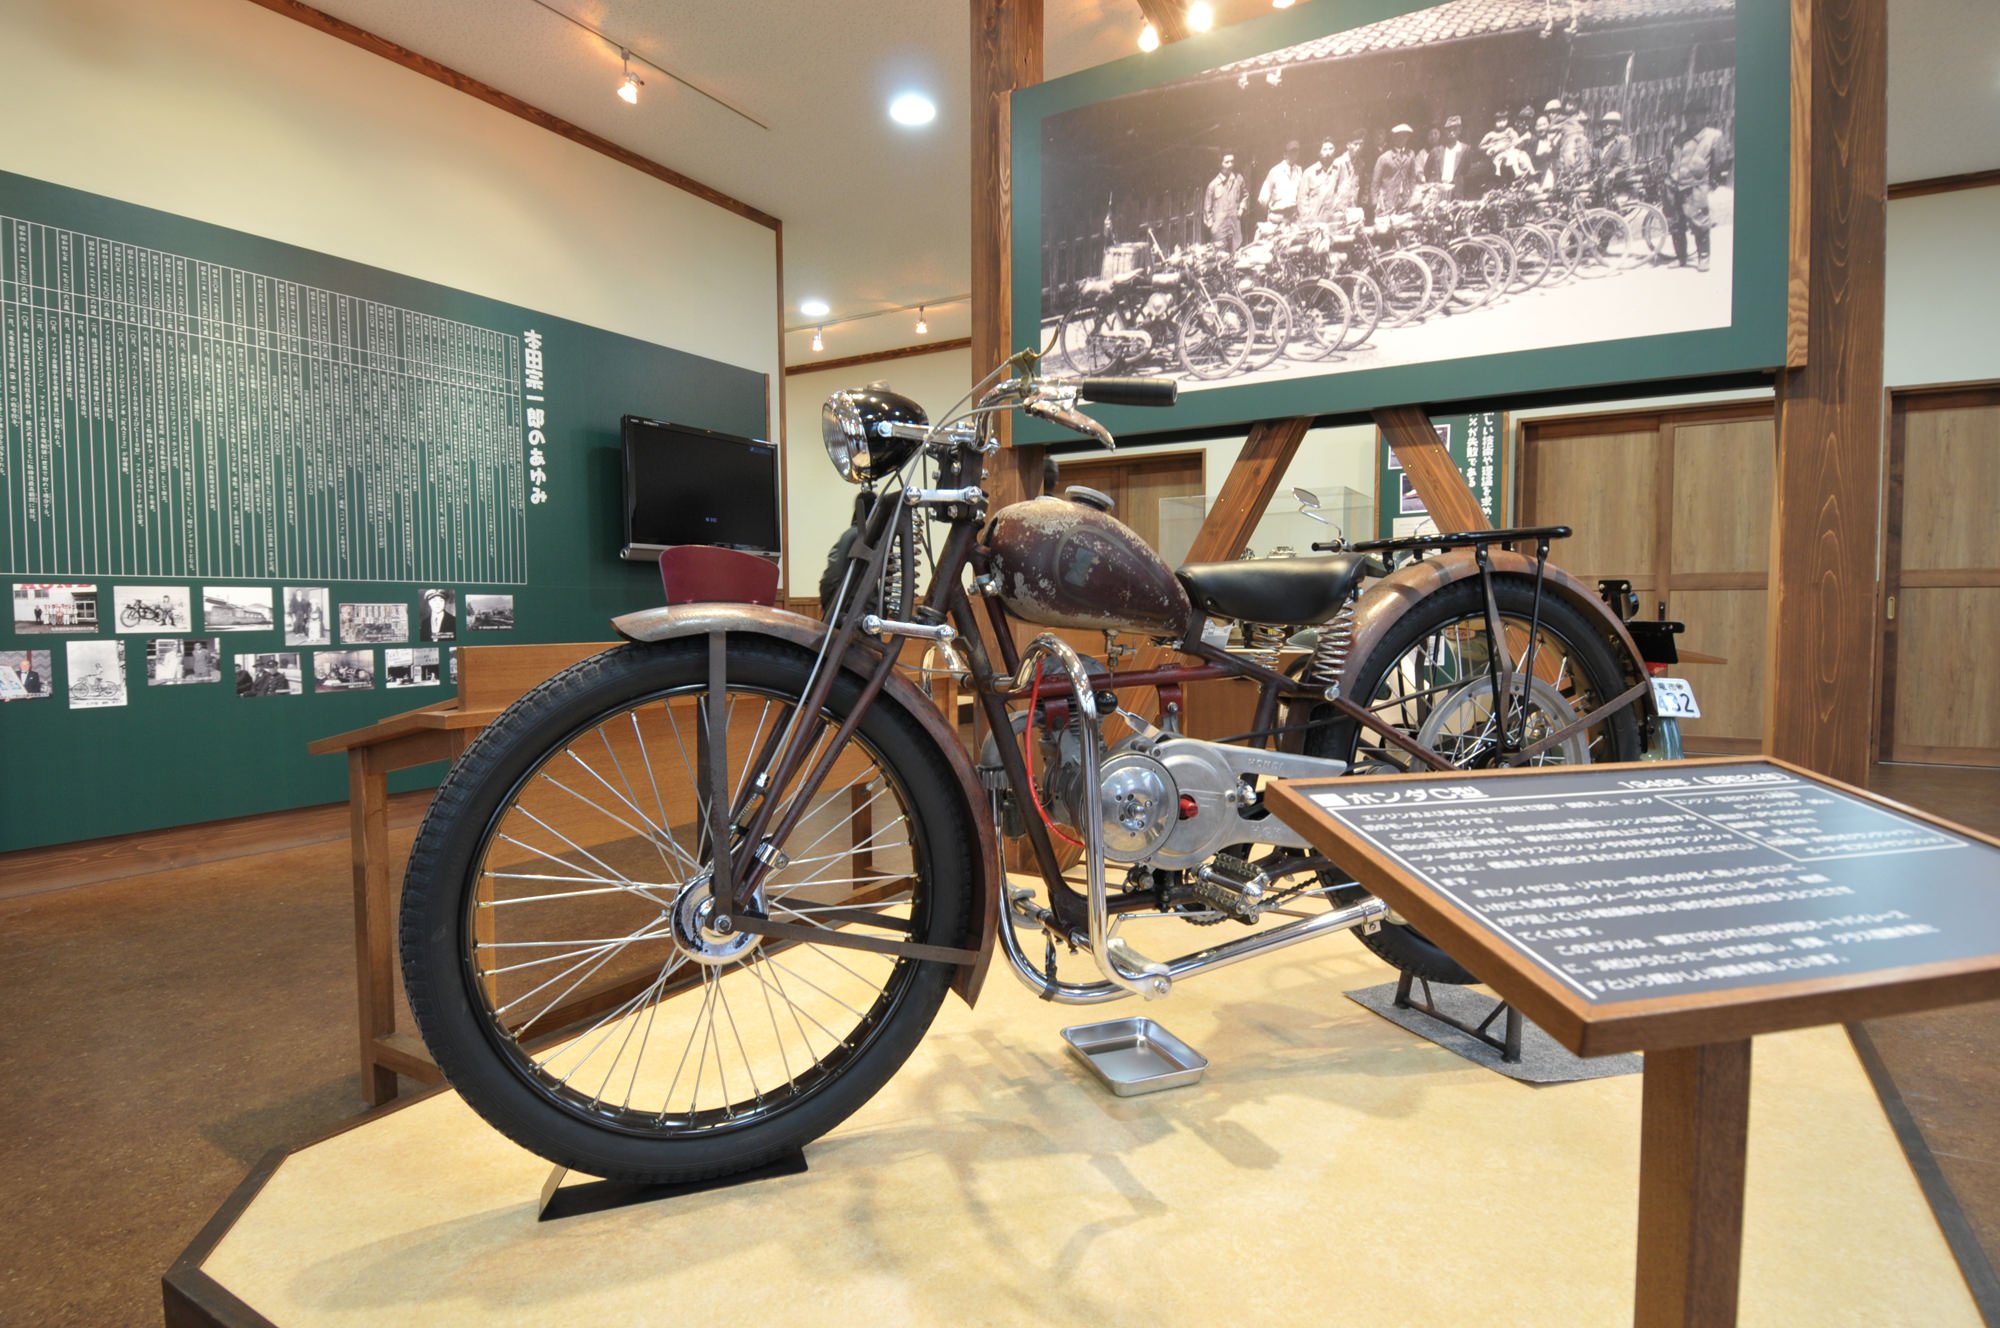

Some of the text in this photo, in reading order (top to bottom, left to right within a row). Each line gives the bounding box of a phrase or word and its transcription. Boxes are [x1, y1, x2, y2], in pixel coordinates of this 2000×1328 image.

[524, 329, 547, 505] 本田宗一郎のあゆみ
[1480, 412, 1495, 520] しい技術や理論を求め
[1346, 785, 1489, 805] ホンダC型
